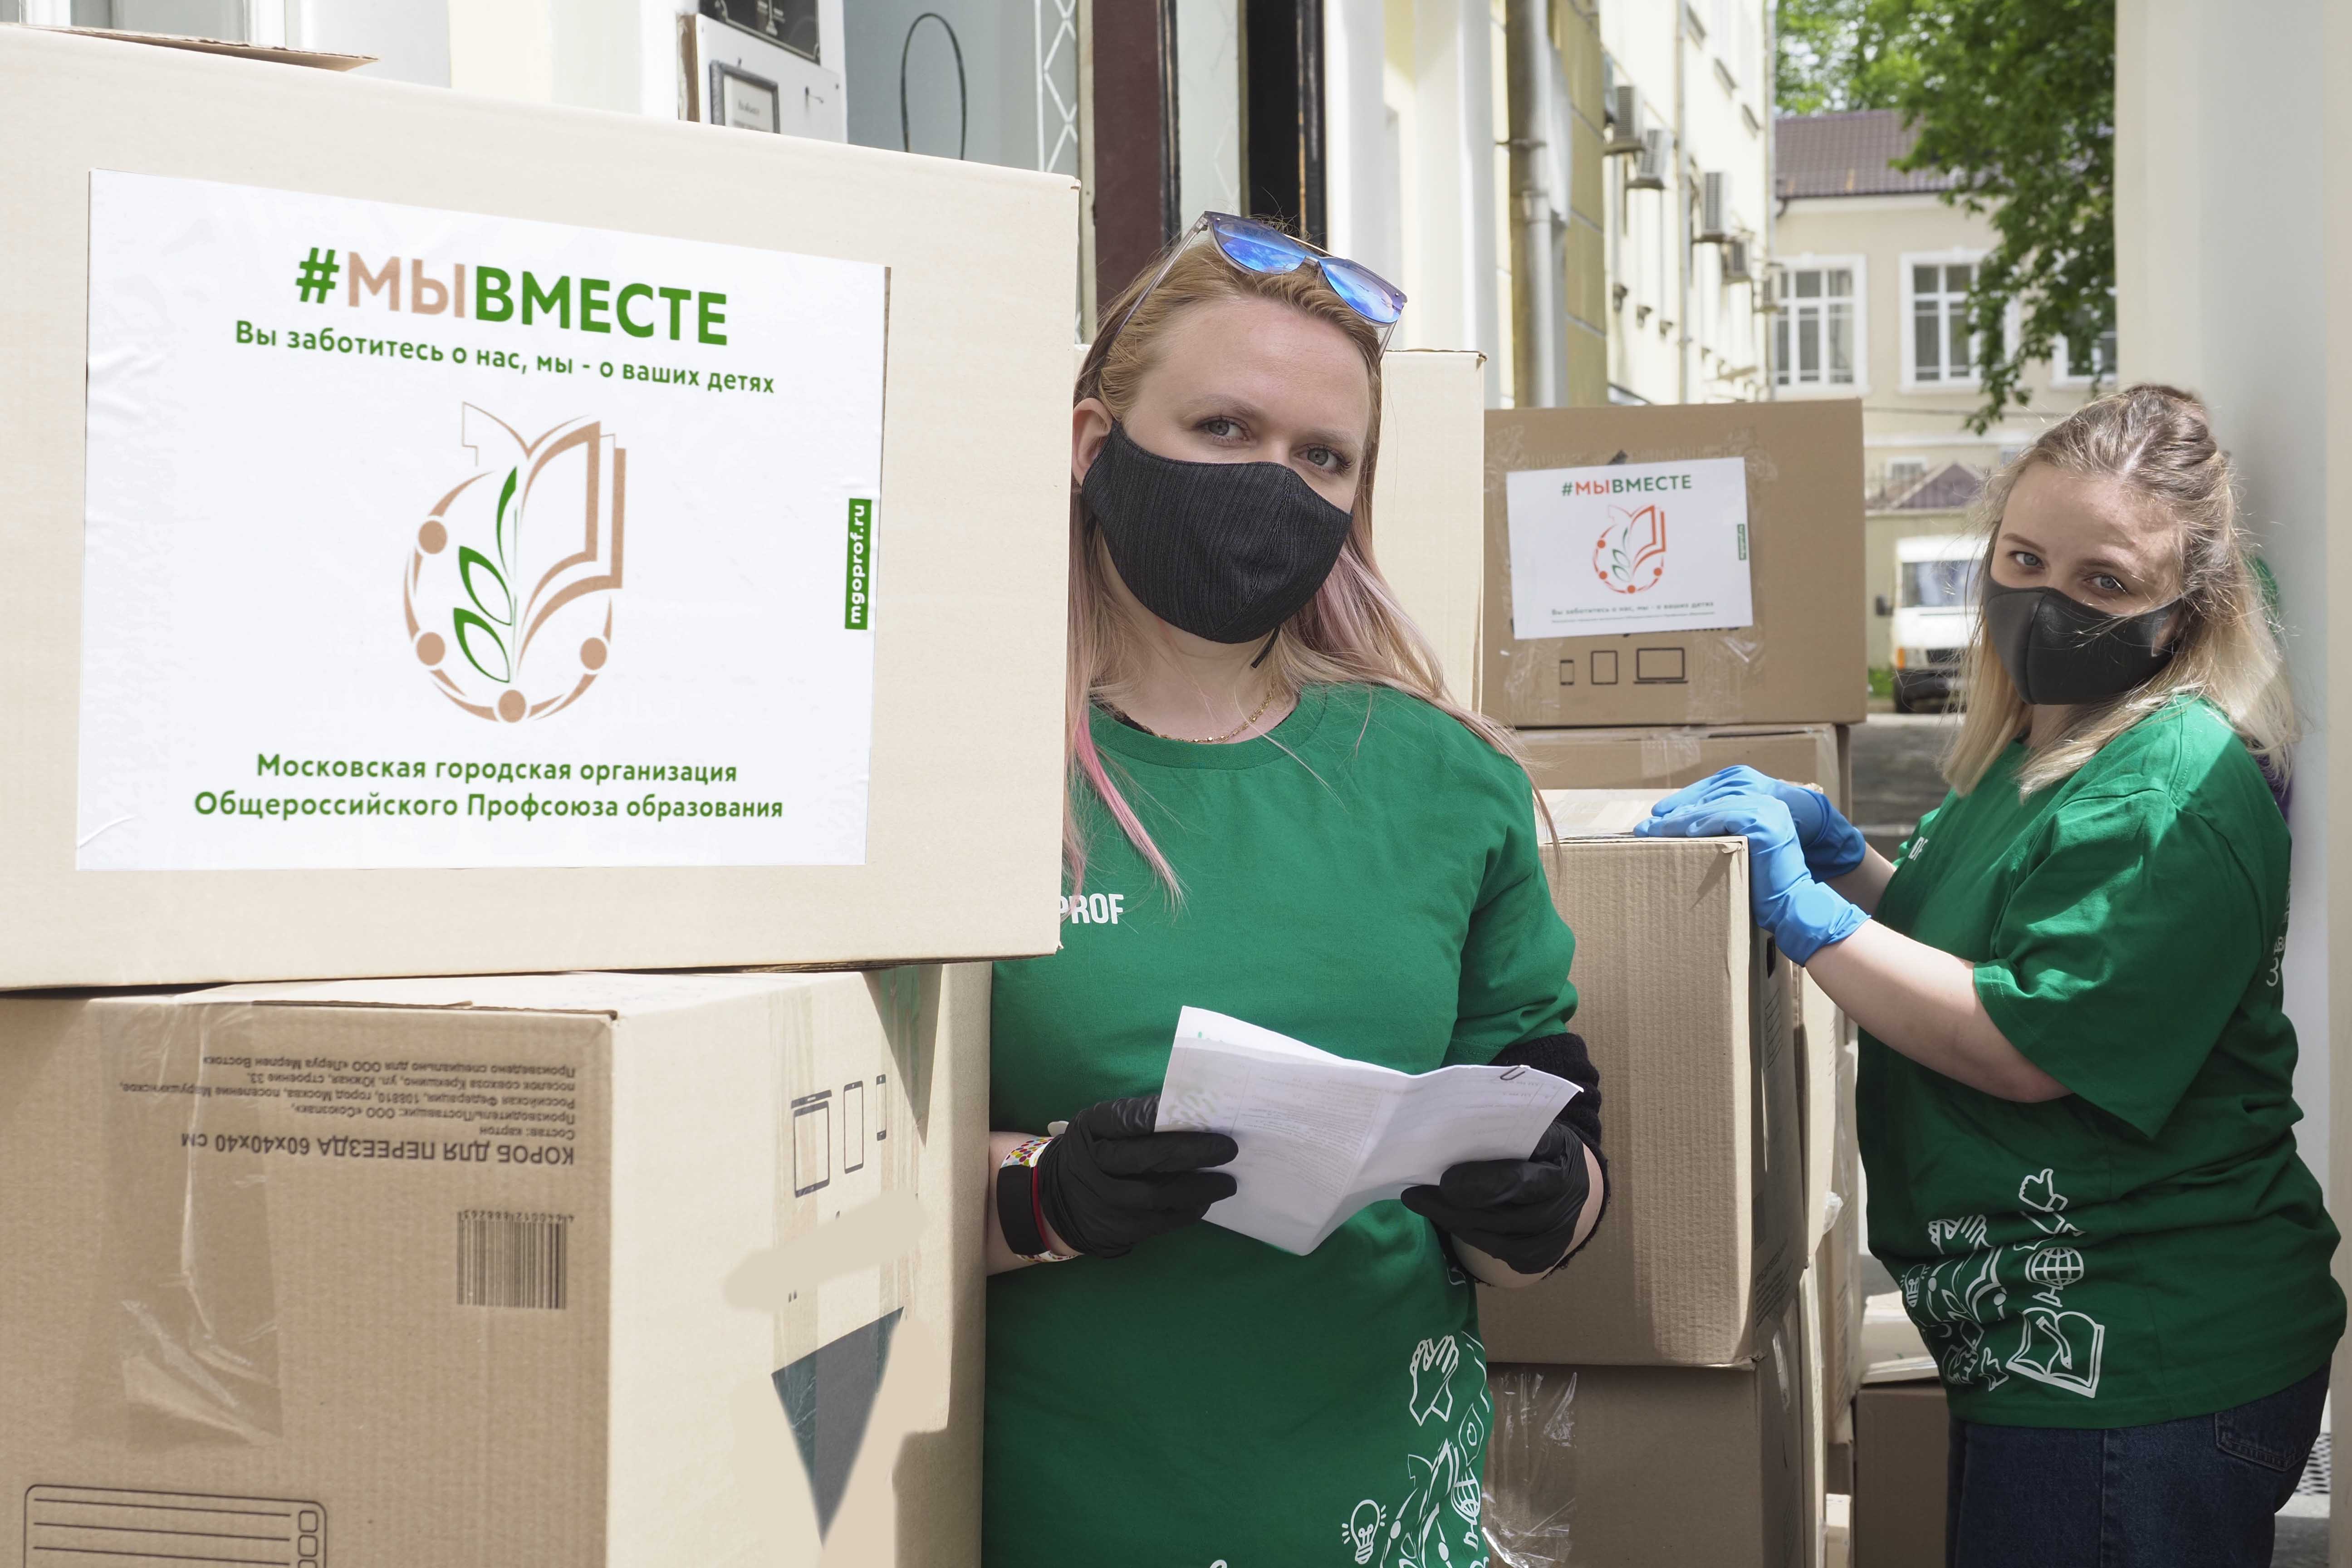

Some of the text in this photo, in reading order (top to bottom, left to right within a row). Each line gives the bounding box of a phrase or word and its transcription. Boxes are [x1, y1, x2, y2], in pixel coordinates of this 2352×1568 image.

[295, 246, 728, 346] #МЫВМЕСТЕ
[236, 319, 277, 346] Вы
[287, 327, 444, 363] заботитесь
[452, 347, 468, 364] о
[476, 349, 527, 375] нас,
[537, 355, 573, 375] мы
[599, 361, 614, 378] о
[622, 363, 699, 386] ваших
[707, 372, 774, 394] детях
[1561, 474, 1692, 496] #МЫВМЕСТЕ
[850, 505, 866, 624] mgoprof.ru
[257, 753, 737, 785] Московская городская организация
[195, 789, 784, 822] Общероссийского Профсоюза образования
[501, 1095, 576, 1109] Российская
[479, 1126, 576, 1140] Состав: картон
[317, 1134, 436, 1160] ПЕРЕЕЗДА
[443, 1140, 490, 1161] ДЛЯ
[497, 1144, 575, 1165] КОРОБ
